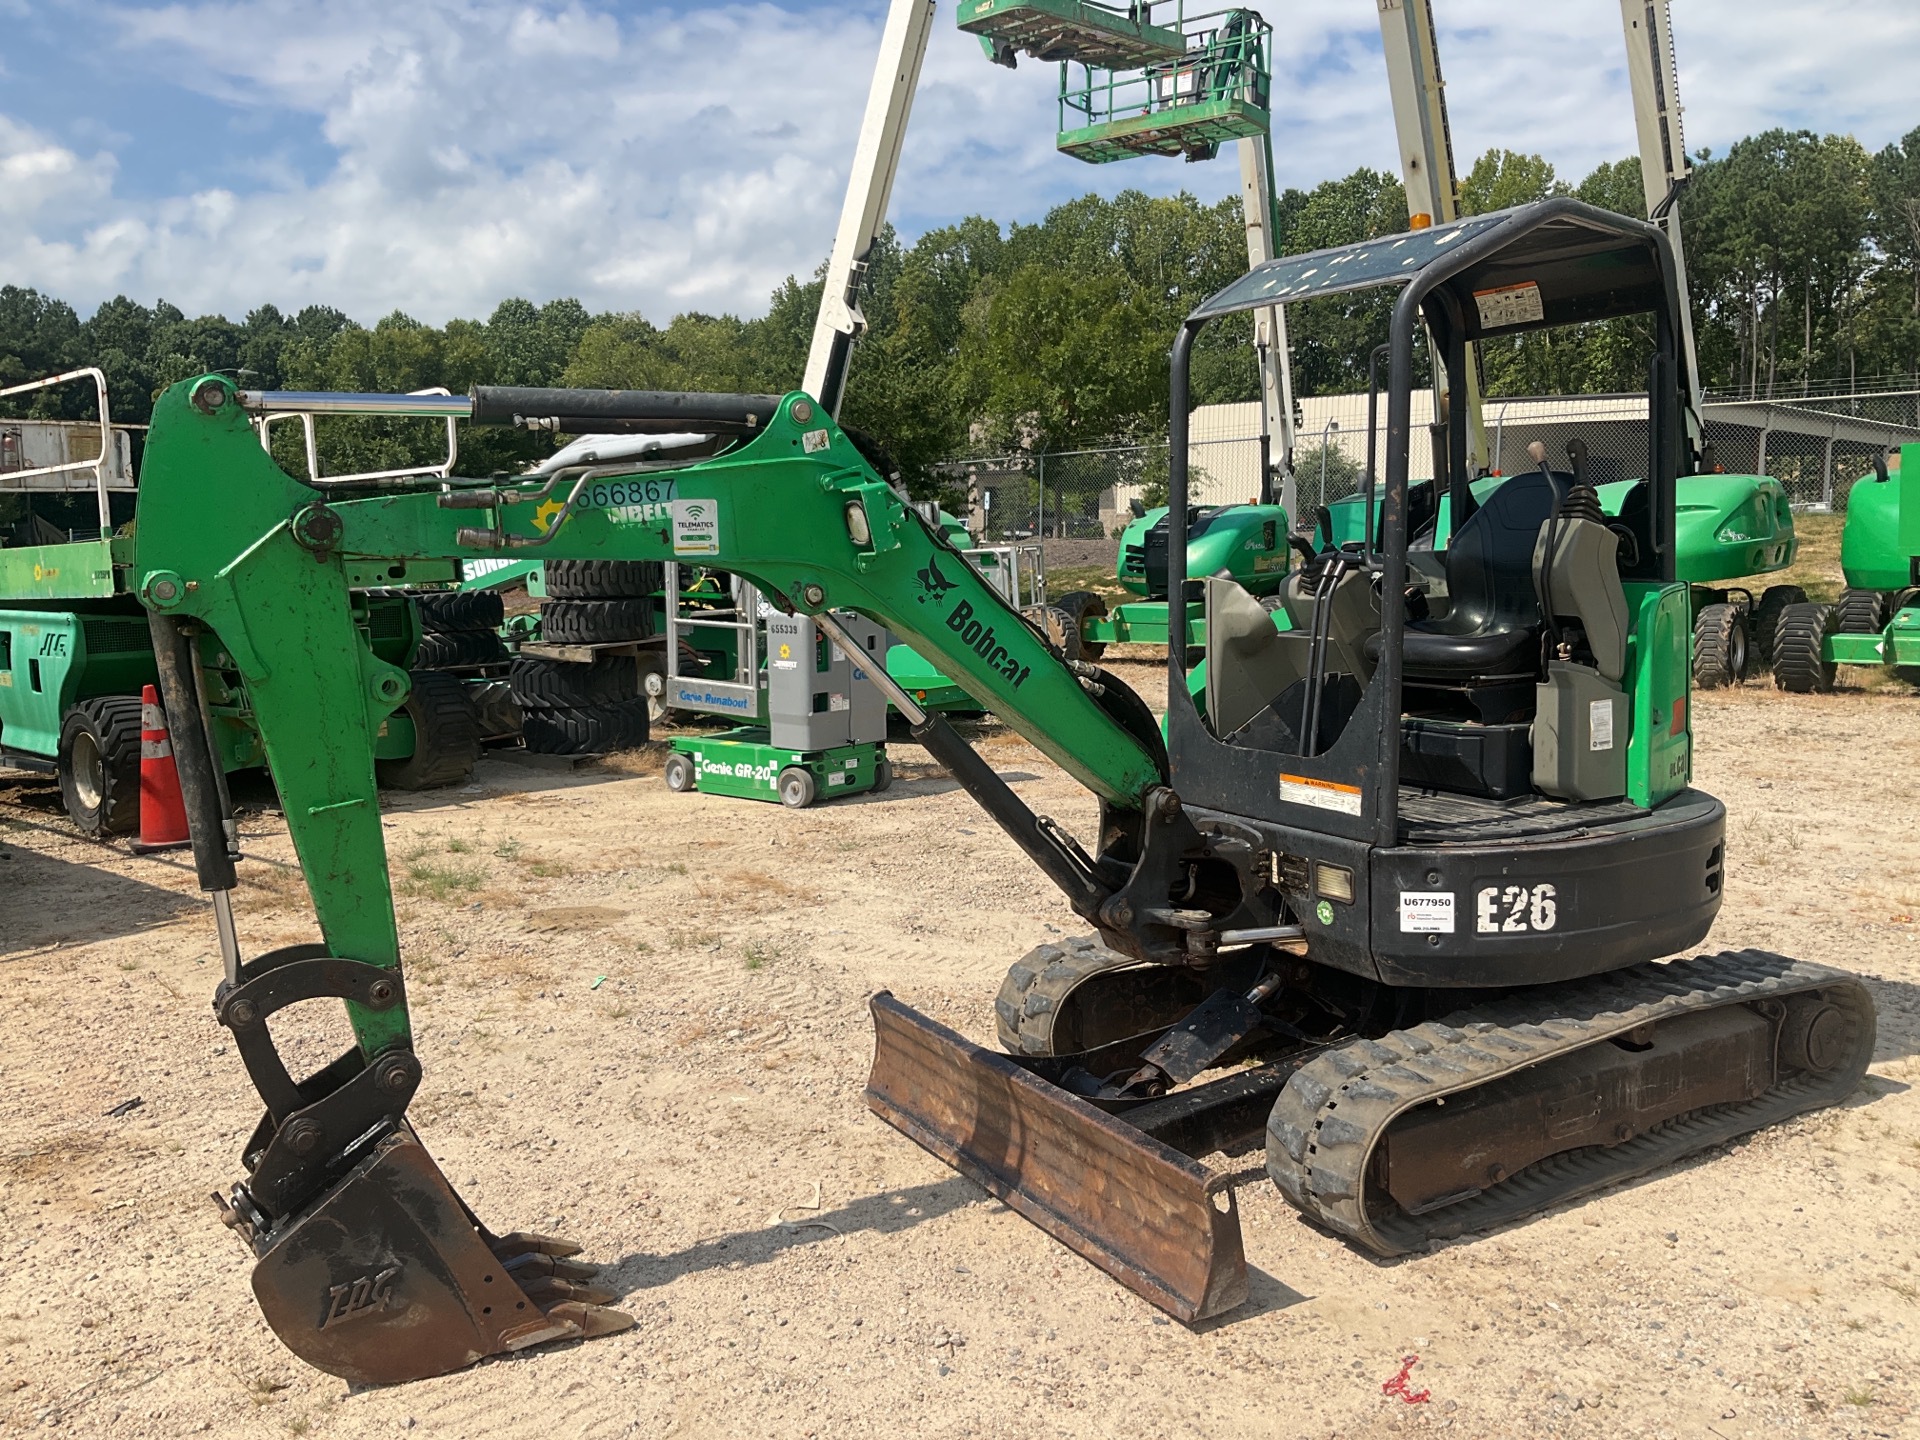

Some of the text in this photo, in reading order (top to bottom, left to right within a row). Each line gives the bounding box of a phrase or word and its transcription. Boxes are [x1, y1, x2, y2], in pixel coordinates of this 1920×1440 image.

[577, 478, 675, 508] 666867
[678, 521, 714, 529] TELEMATICS
[771, 624, 798, 634] 655339
[946, 599, 1031, 692] Bobcat
[705, 693, 748, 709] Runabout
[702, 759, 770, 780] Genie GR-20
[1310, 780, 1335, 789] WARNING
[1404, 898, 1451, 906] U677950
[1477, 884, 1556, 932] E26
[1407, 912, 1416, 920] rb
